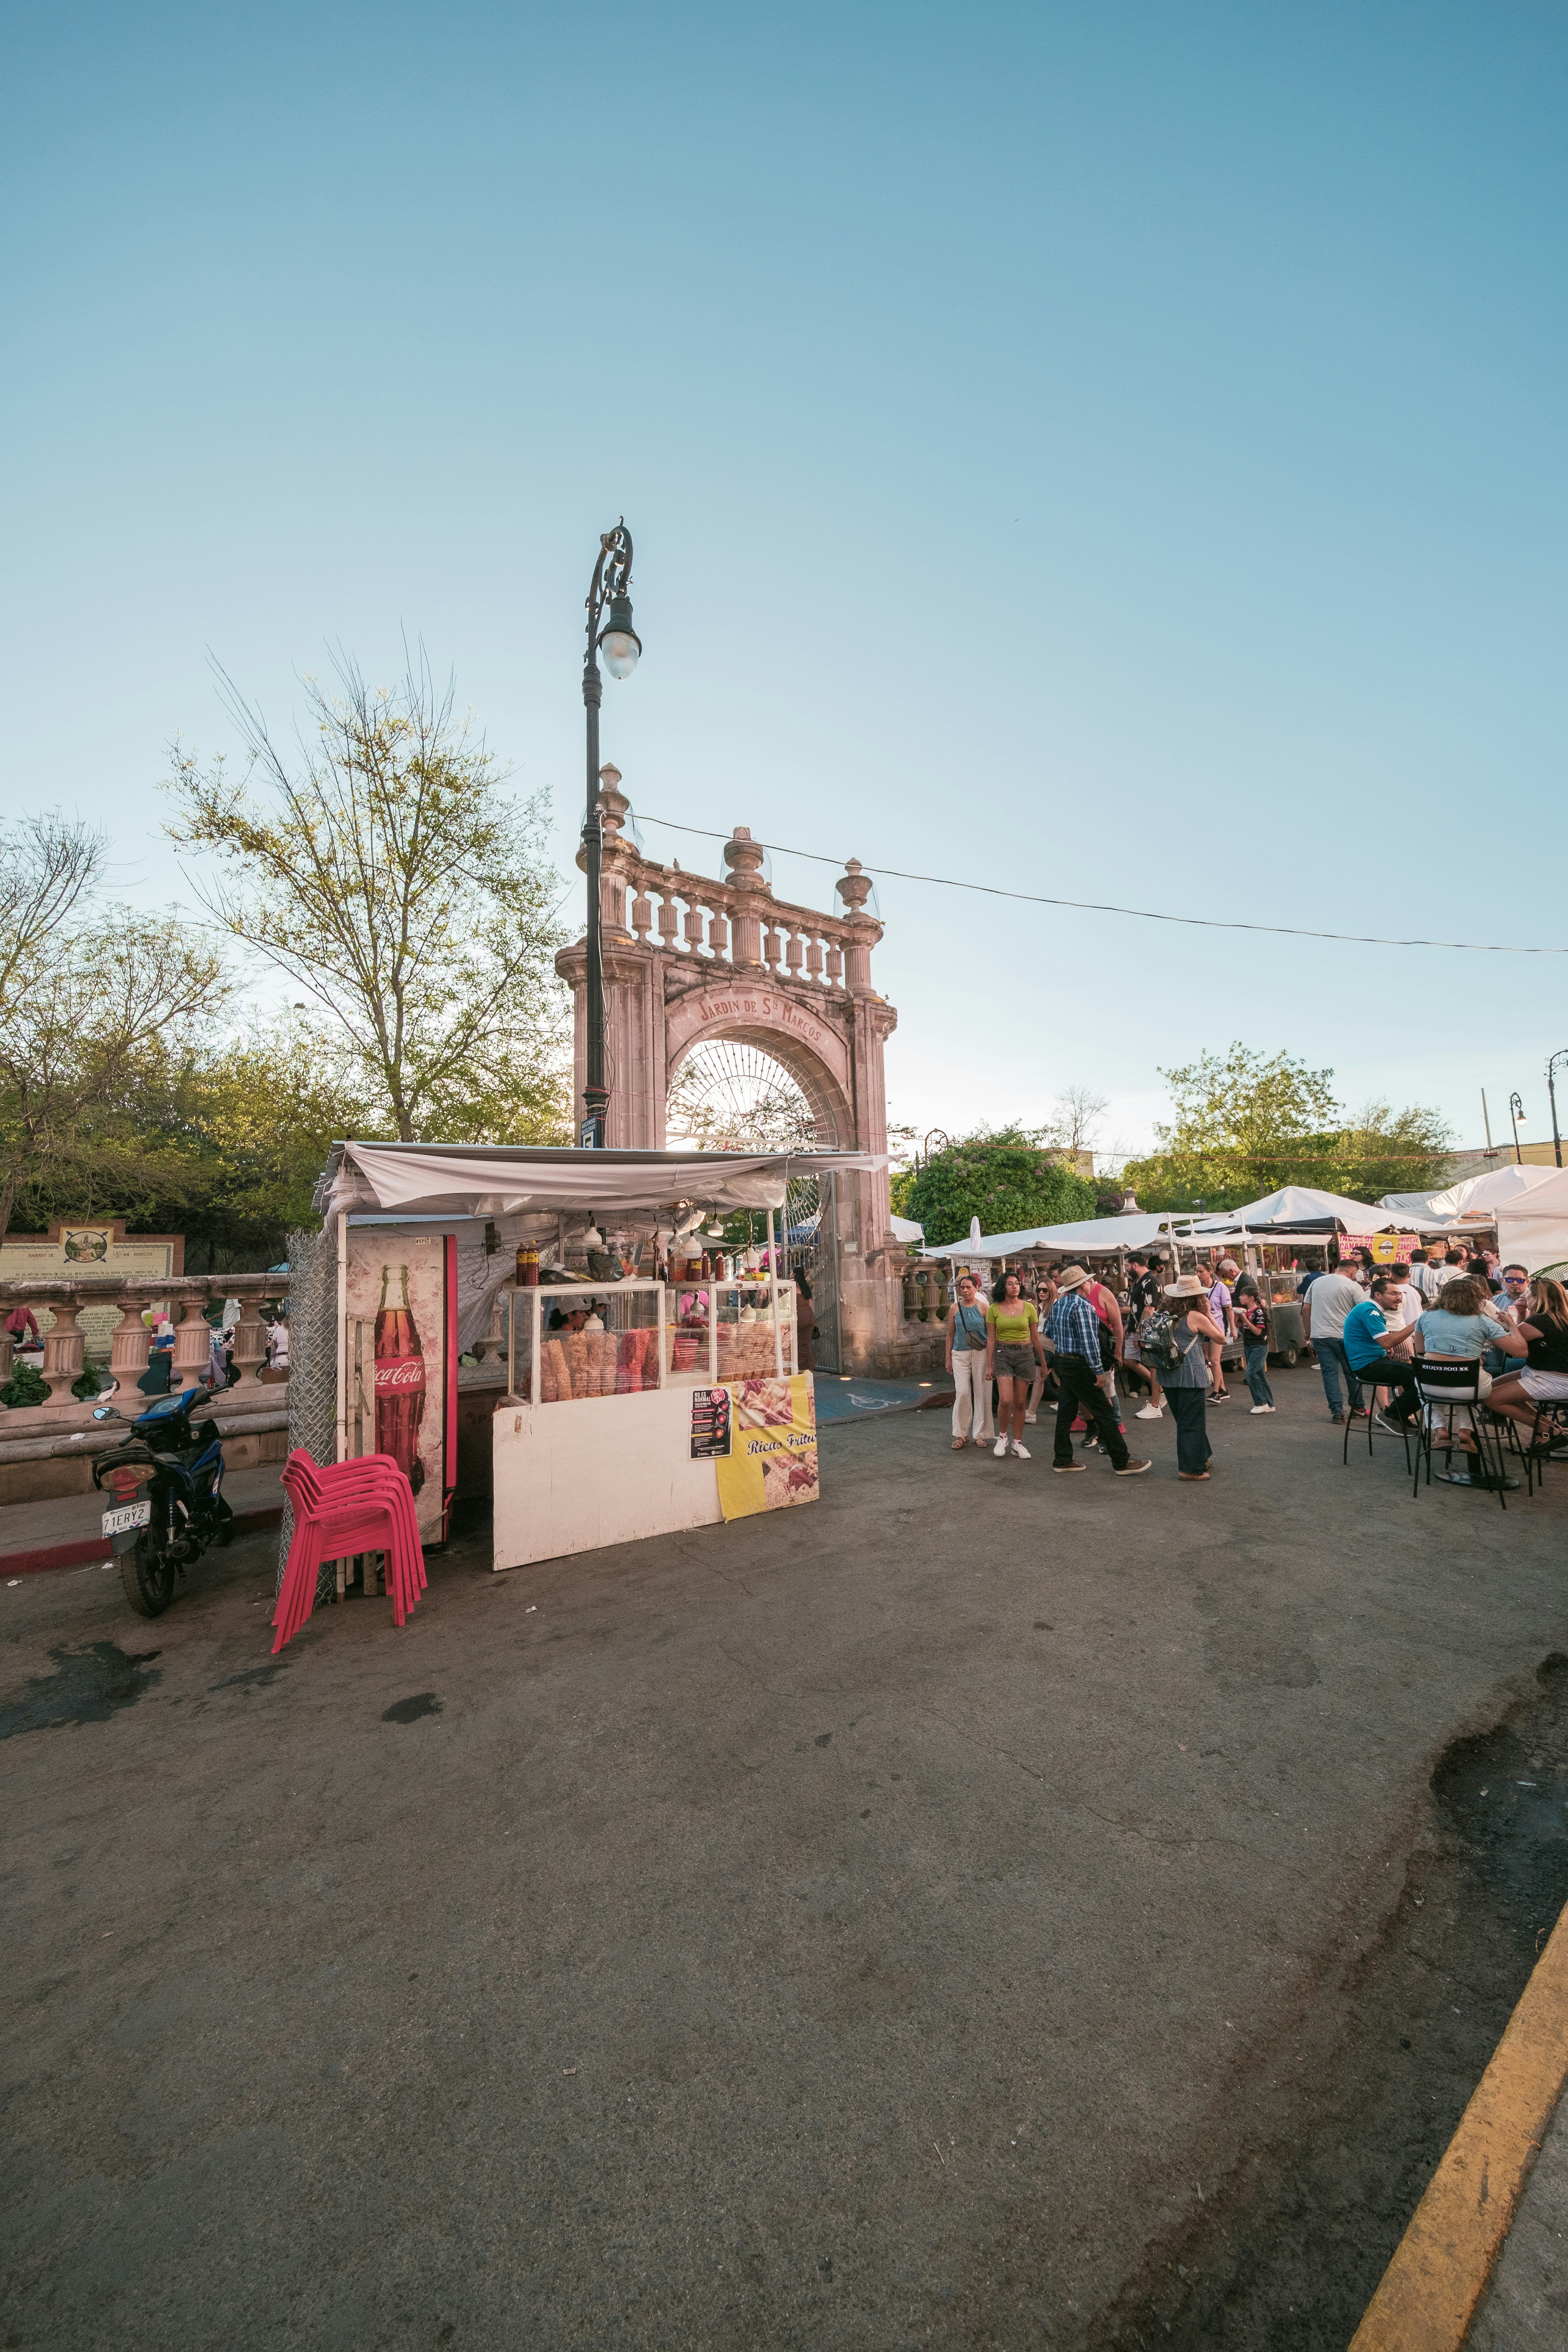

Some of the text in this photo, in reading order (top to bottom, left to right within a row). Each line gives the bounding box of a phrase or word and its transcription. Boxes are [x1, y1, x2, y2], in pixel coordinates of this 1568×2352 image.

[698, 1000, 740, 1021] JARDIN
[744, 1000, 756, 1013] DE
[782, 1003, 821, 1041] MARCOS
[581, 1124, 596, 1136] DESCENSO
[582, 1117, 596, 1129] ASCENSO
[747, 1433, 816, 1455] Ricas Fritu
[104, 1508, 144, 1530] 71ERY2
